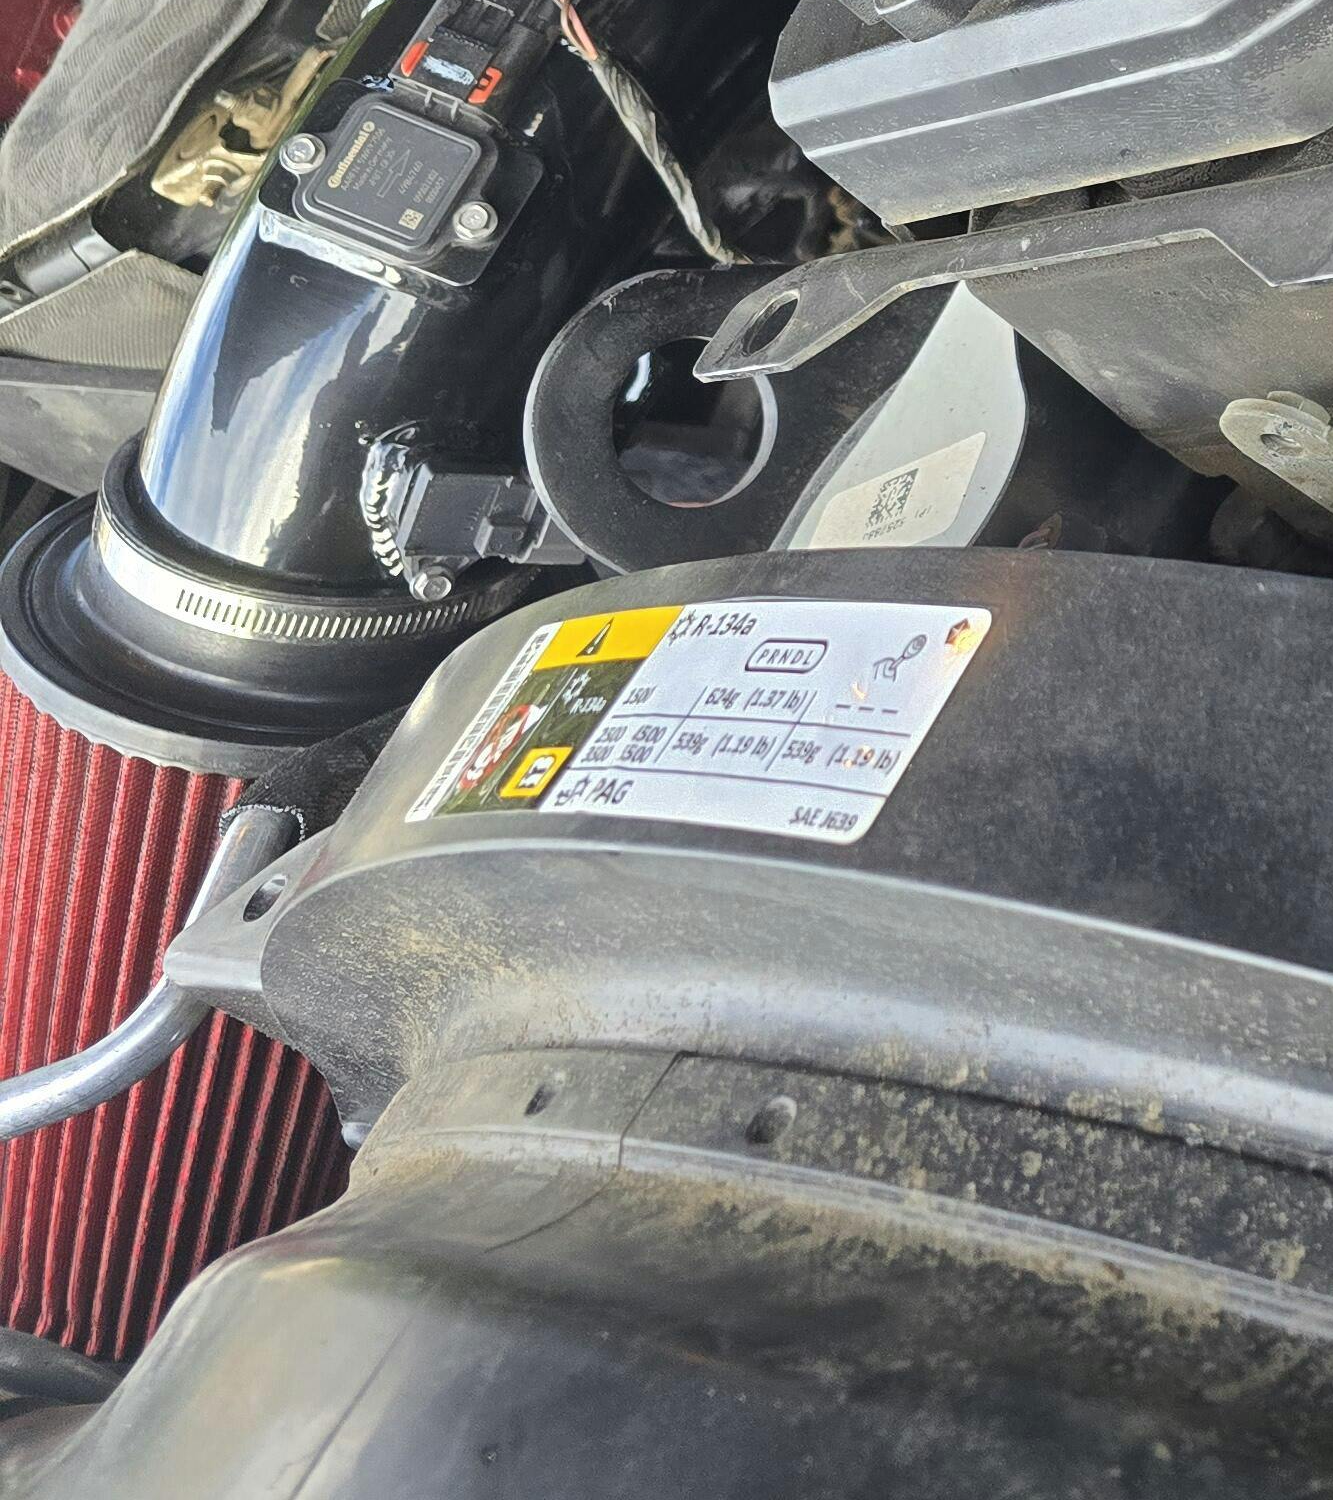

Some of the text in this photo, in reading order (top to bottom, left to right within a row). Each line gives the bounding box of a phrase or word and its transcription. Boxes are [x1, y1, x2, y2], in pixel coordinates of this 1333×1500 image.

[691, 613, 756, 636] R-134a
[705, 688, 740, 709] 624g
[743, 688, 786, 710] (1.37
[782, 690, 808, 713] lb)
[672, 732, 900, 774] 539g (1.19 lb) 539g (1.19 lb)
[586, 778, 633, 804] PAG
[789, 807, 858, 831] SAE J639
